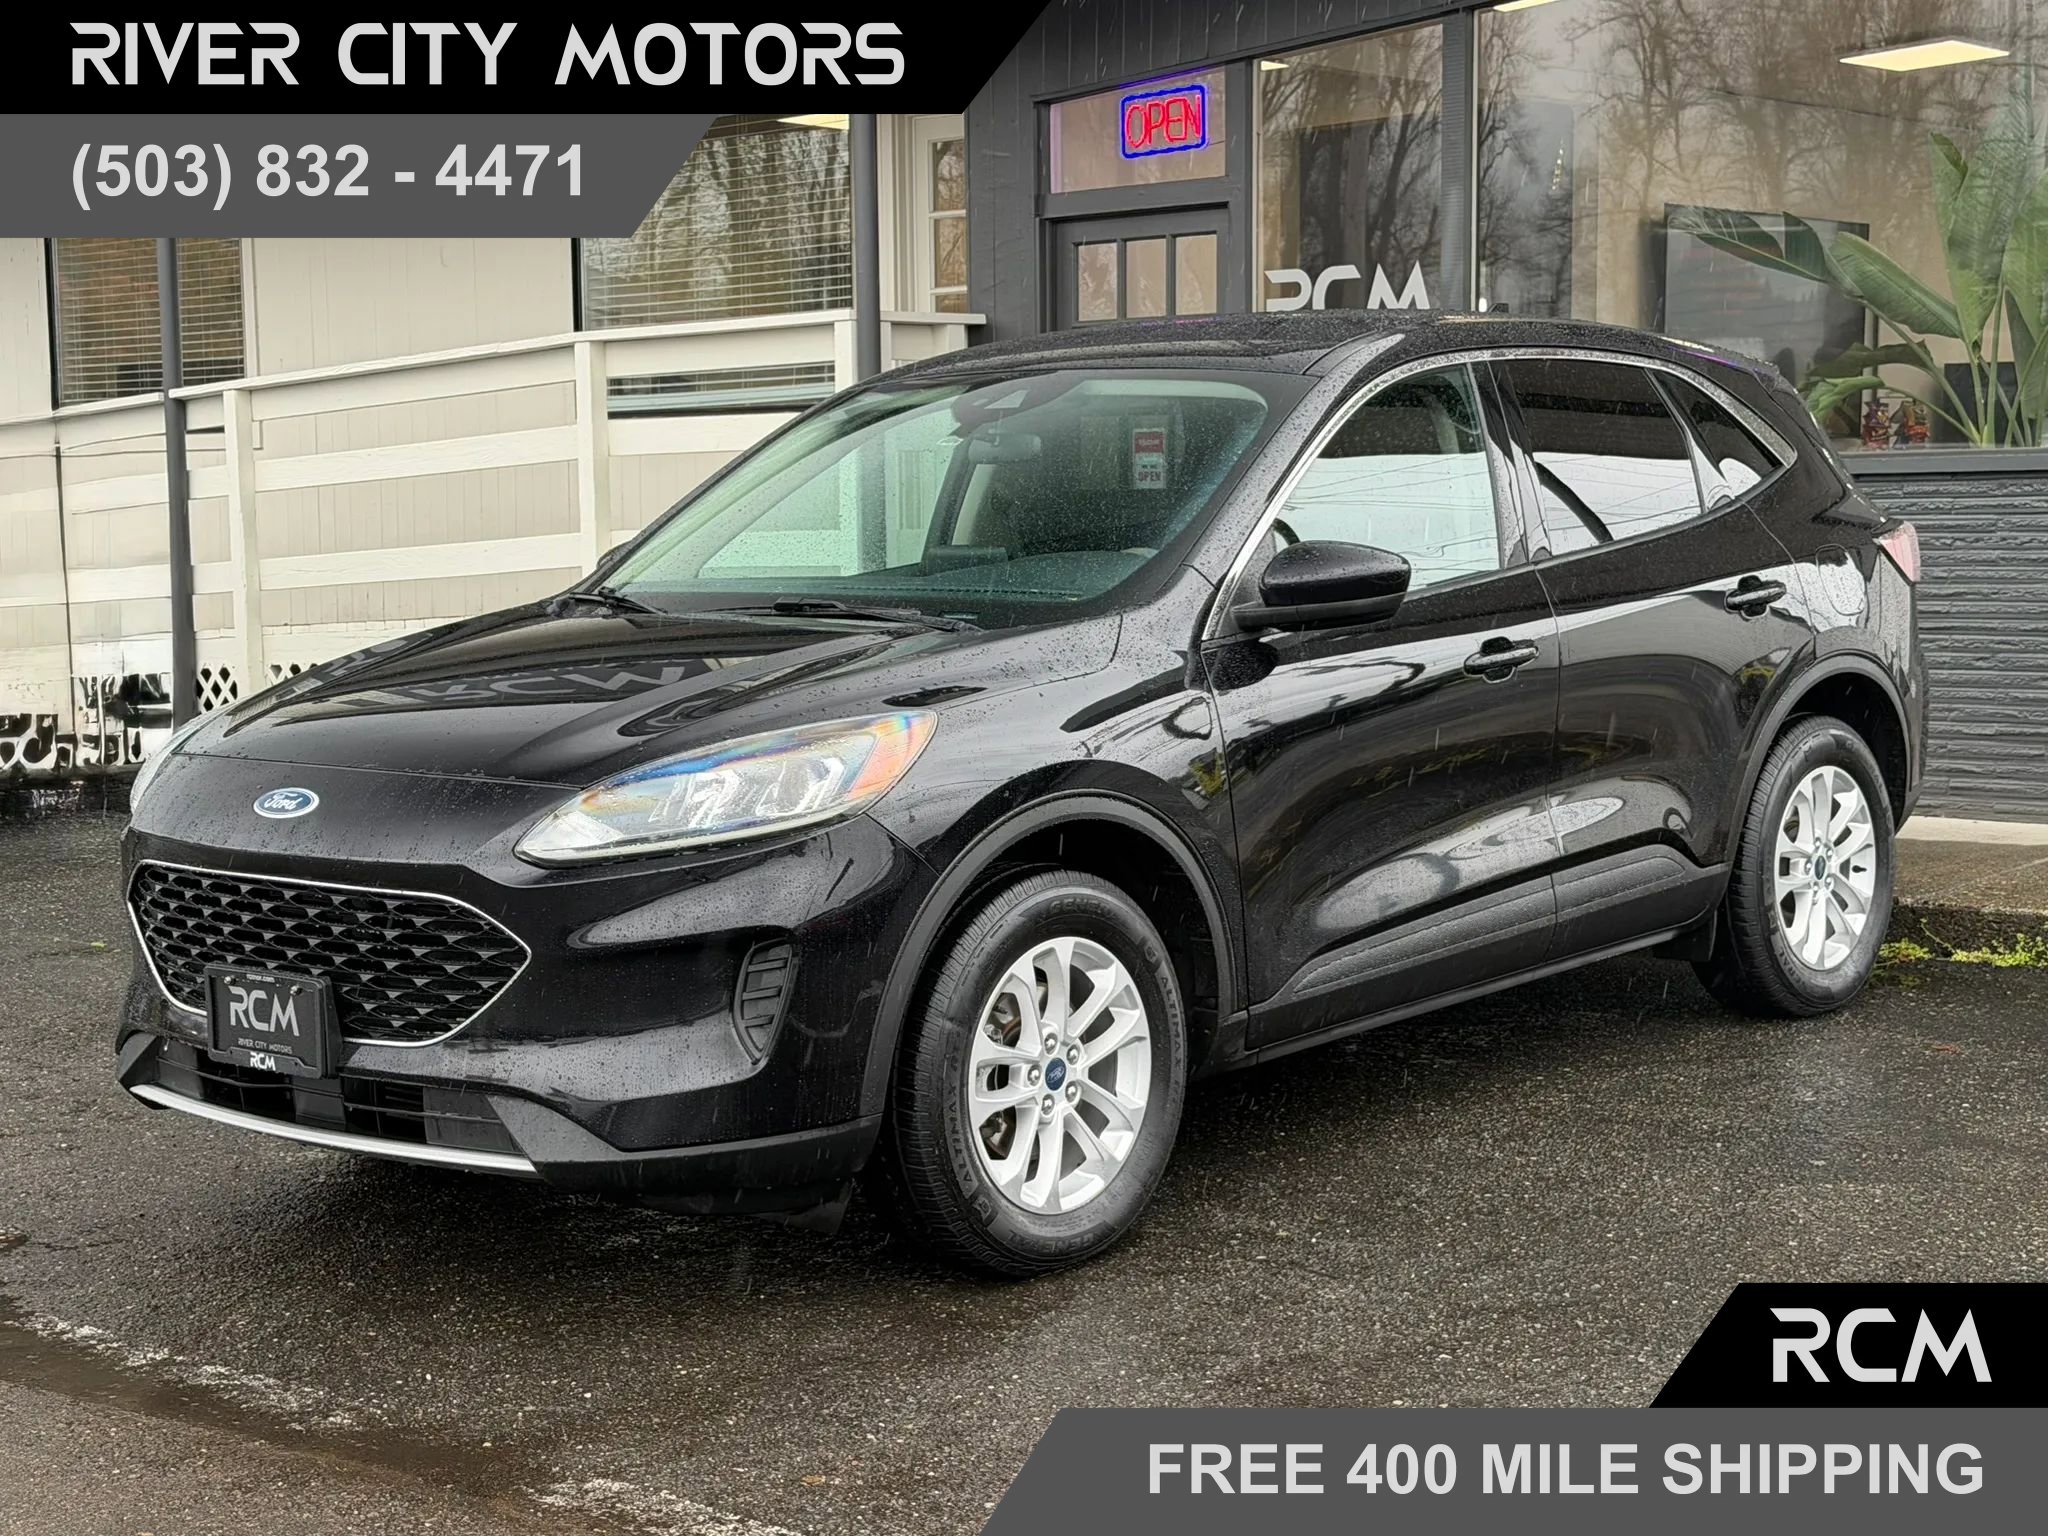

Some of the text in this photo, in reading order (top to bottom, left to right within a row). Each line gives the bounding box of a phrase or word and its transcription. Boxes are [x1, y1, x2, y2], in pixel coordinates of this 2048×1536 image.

[1125, 94, 1202, 149] OPEN
[1138, 471, 1162, 482] OPEN
[263, 792, 303, 810] Ford
[228, 985, 300, 1037] RCM
[238, 1037, 293, 1055] RIVER CITY MOTORS
[250, 1051, 276, 1071] RCM
